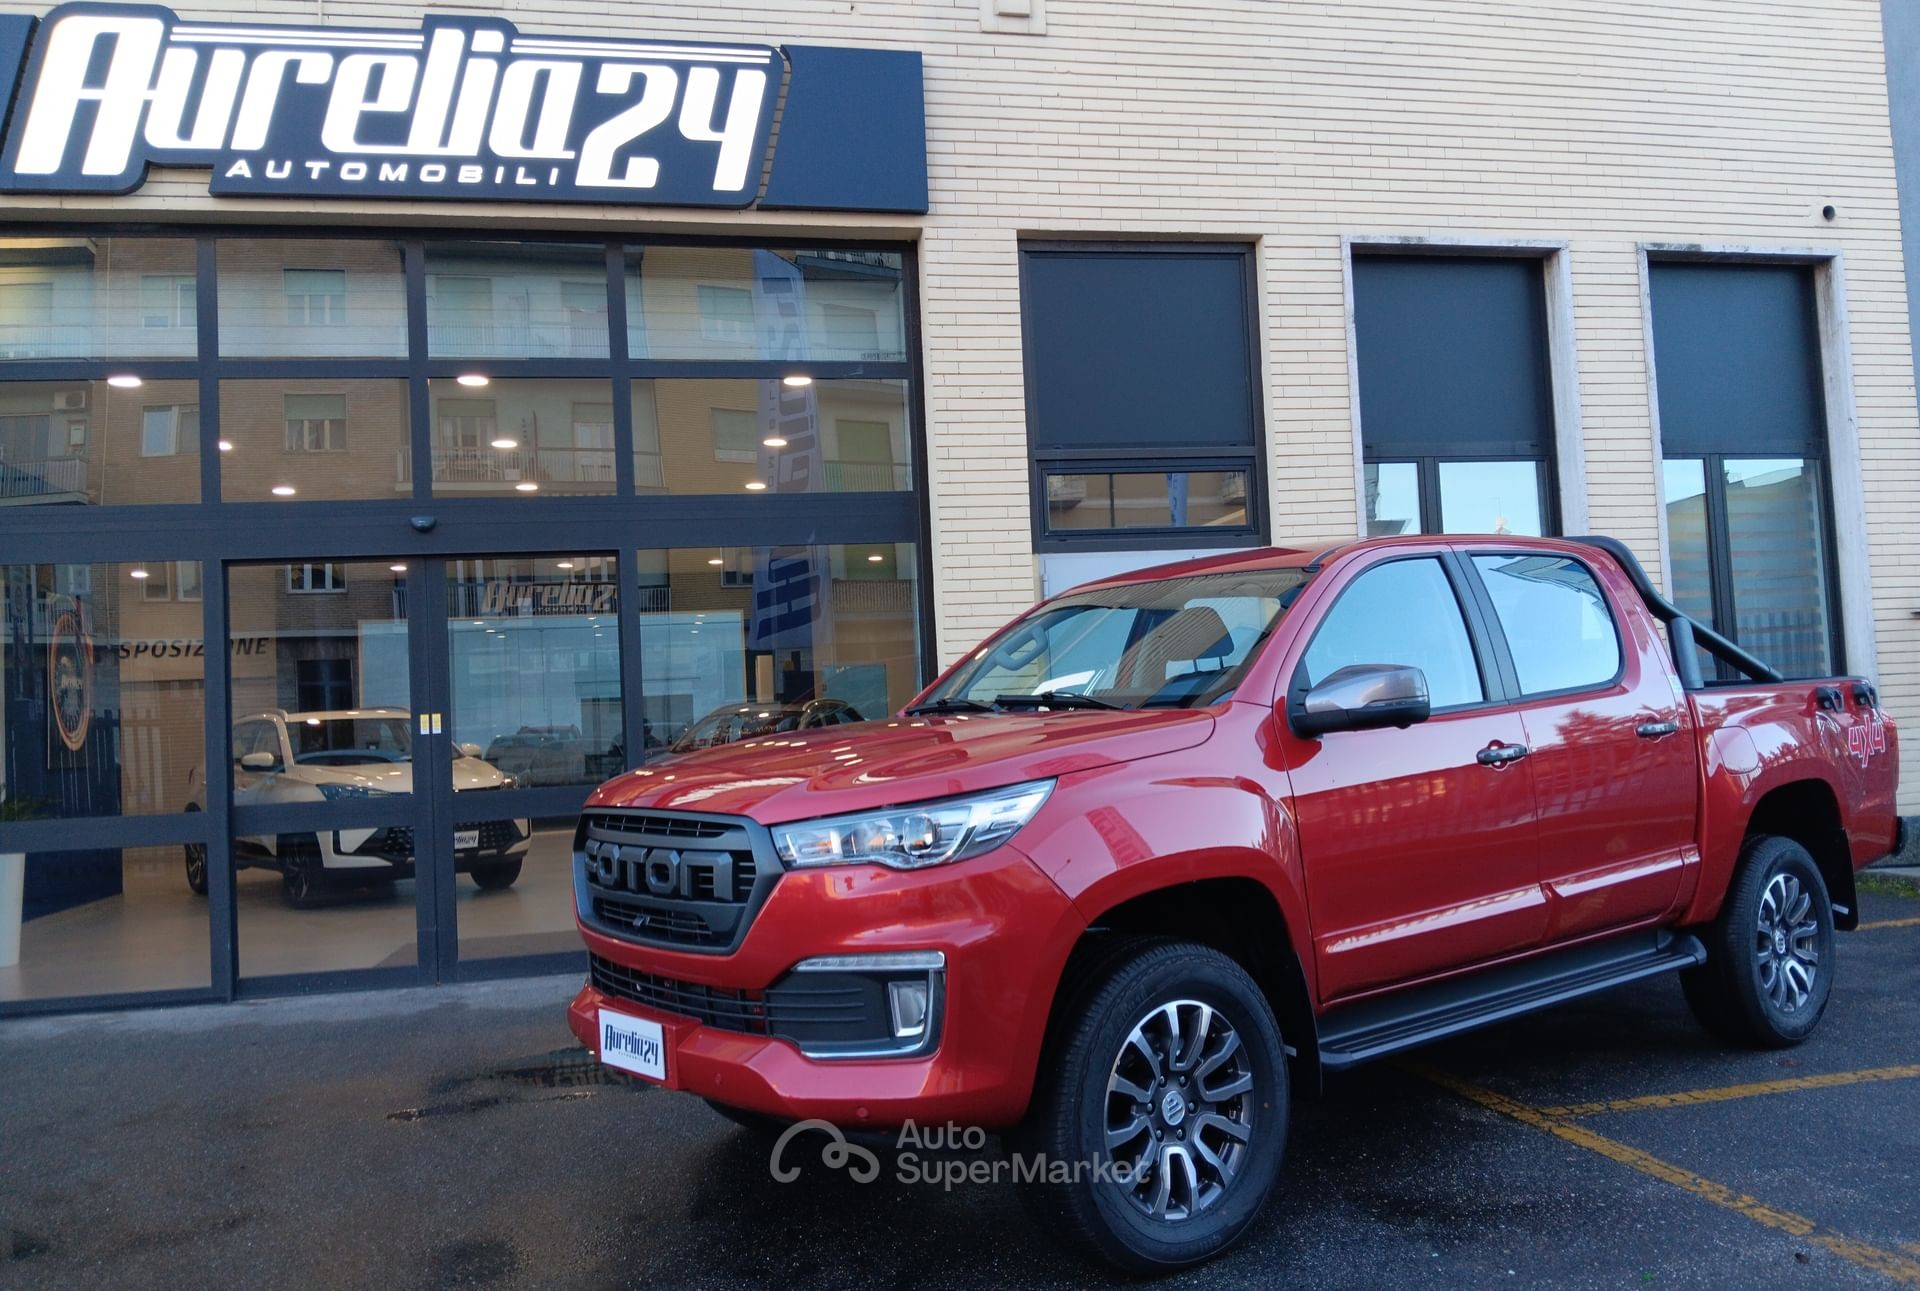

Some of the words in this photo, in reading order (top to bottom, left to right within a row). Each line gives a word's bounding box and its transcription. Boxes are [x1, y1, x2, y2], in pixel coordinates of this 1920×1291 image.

[14, 15, 767, 192] Aurelia24
[225, 160, 560, 186] AUTOMOBILI
[481, 580, 616, 613] Aurelia2
[605, 1024, 658, 1066] Aurelia24
